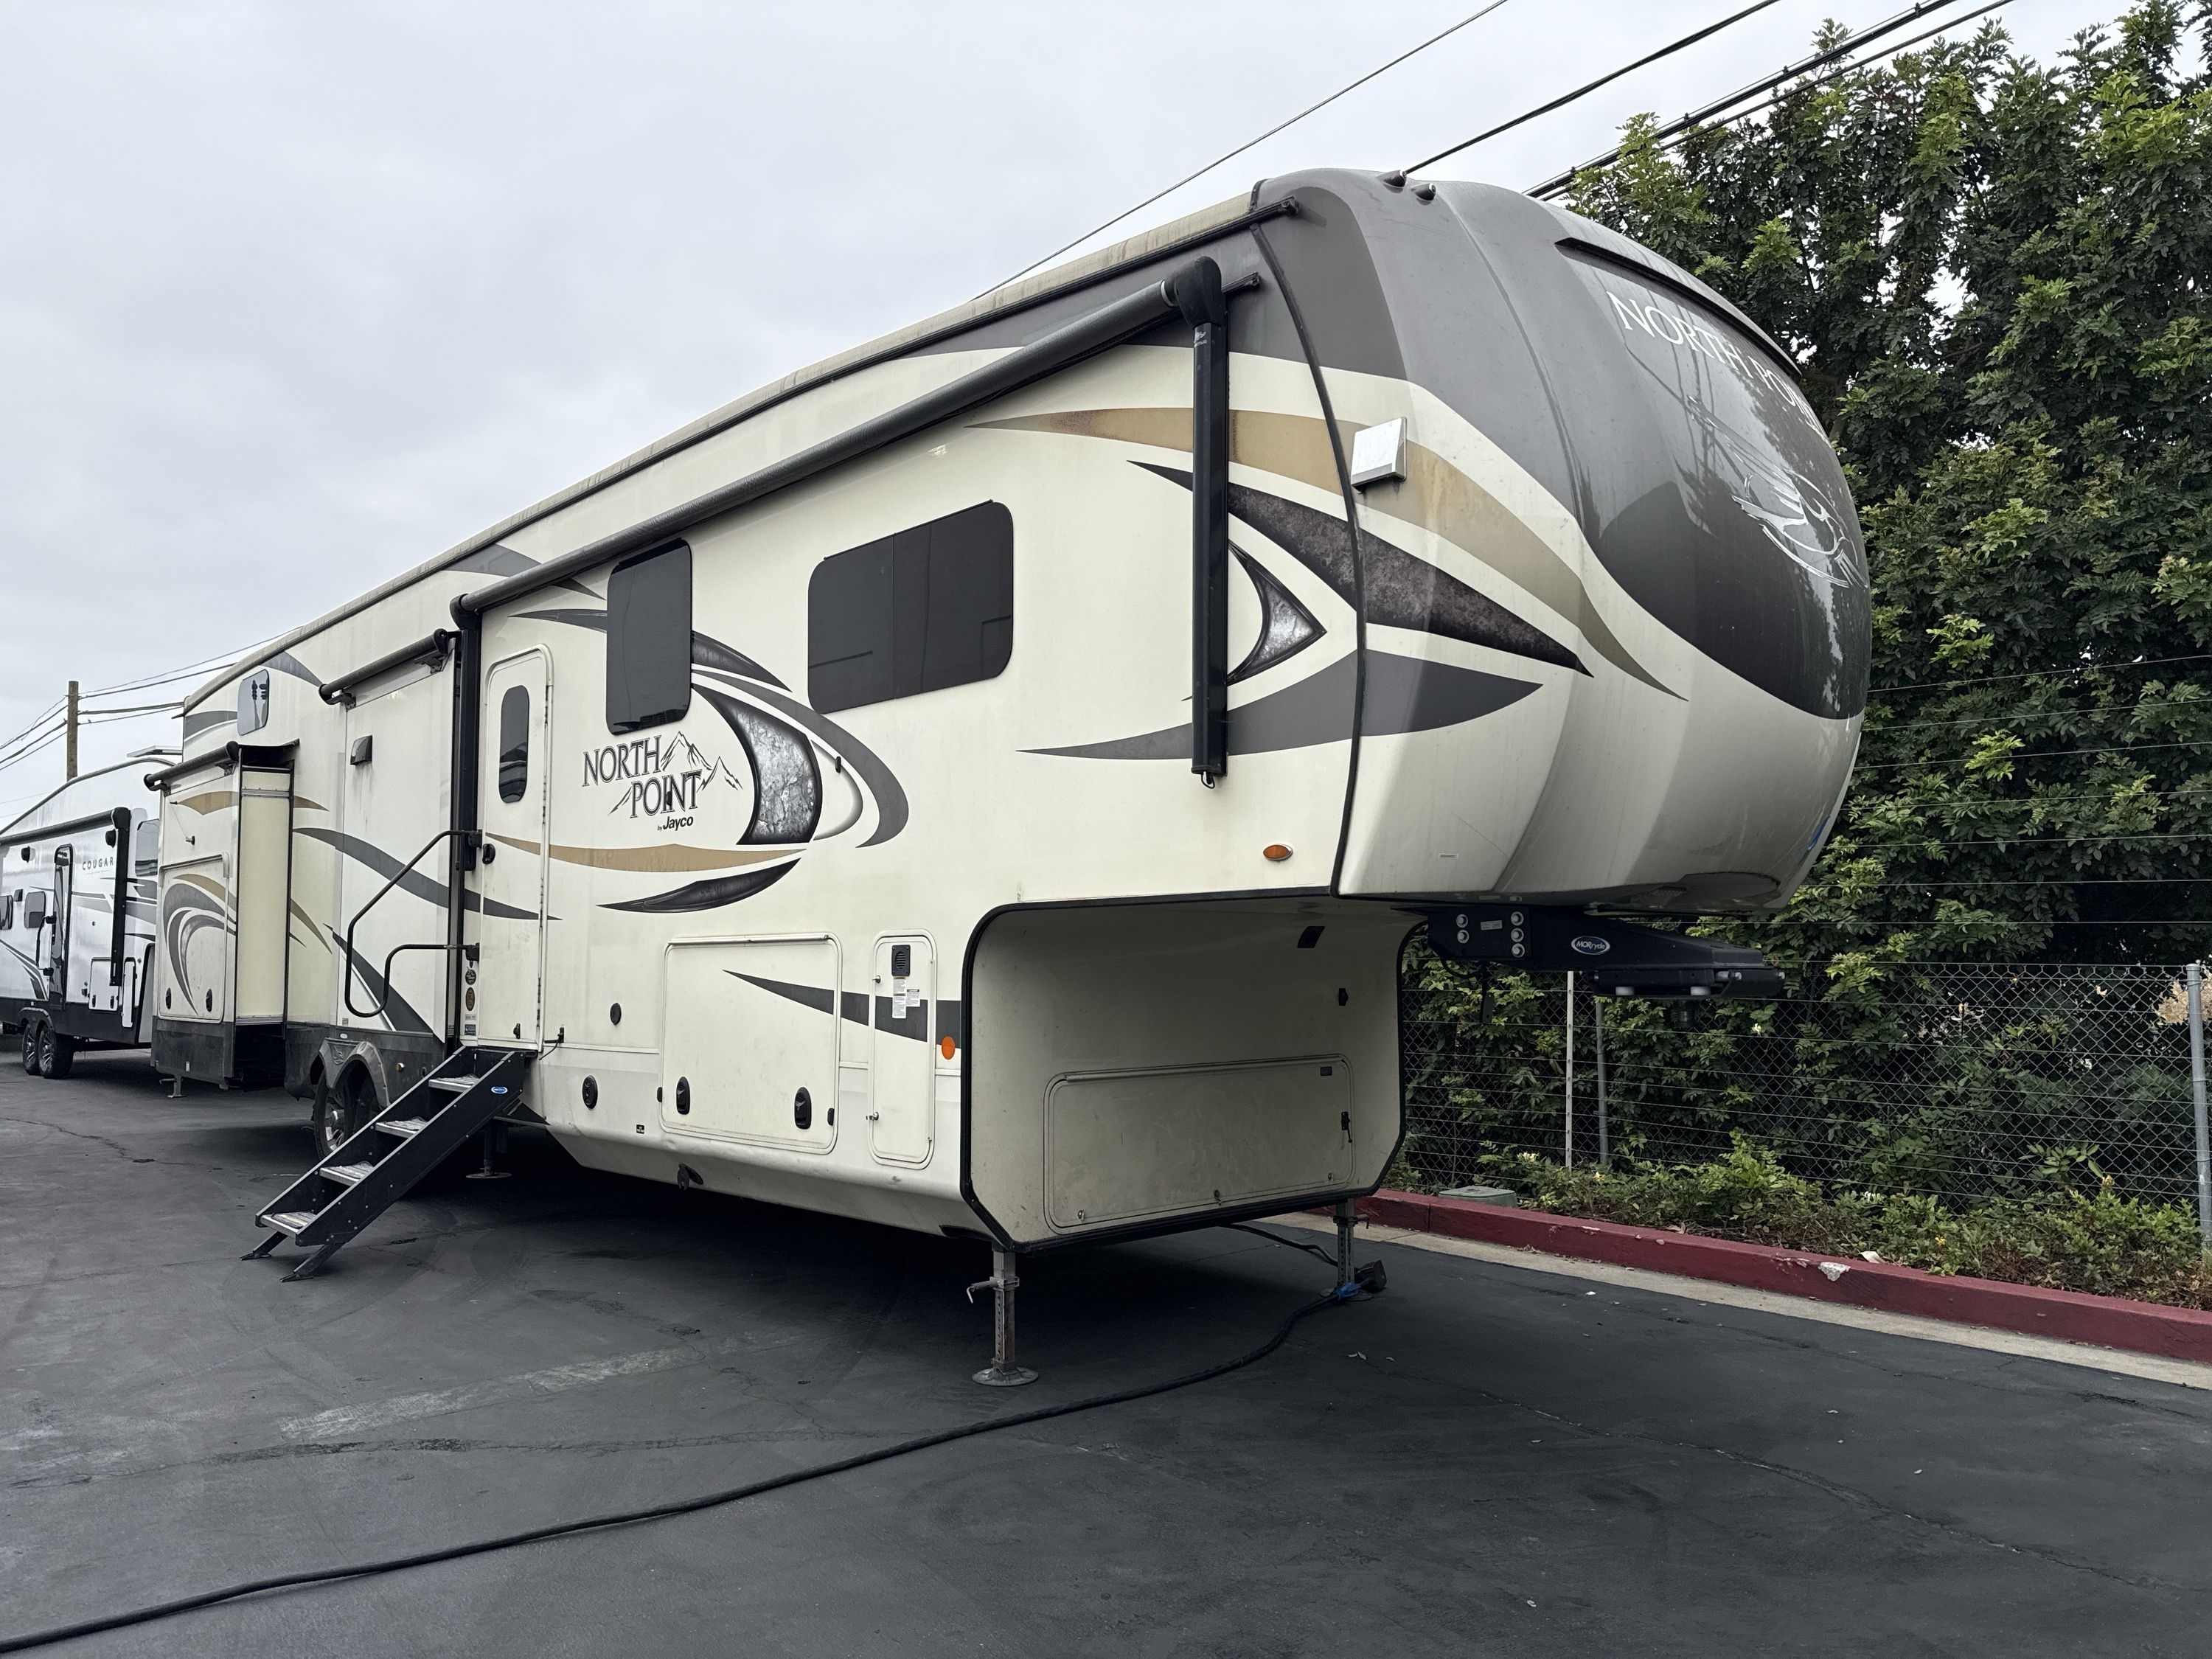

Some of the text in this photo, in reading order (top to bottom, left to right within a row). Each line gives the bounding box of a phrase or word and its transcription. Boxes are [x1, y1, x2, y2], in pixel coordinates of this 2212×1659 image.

[1606, 291, 1754, 379] NORTH
[582, 735, 661, 787] NORTH
[630, 769, 703, 818] POINT
[663, 815, 694, 832] Jayco
[82, 856, 114, 871] COUGAR
